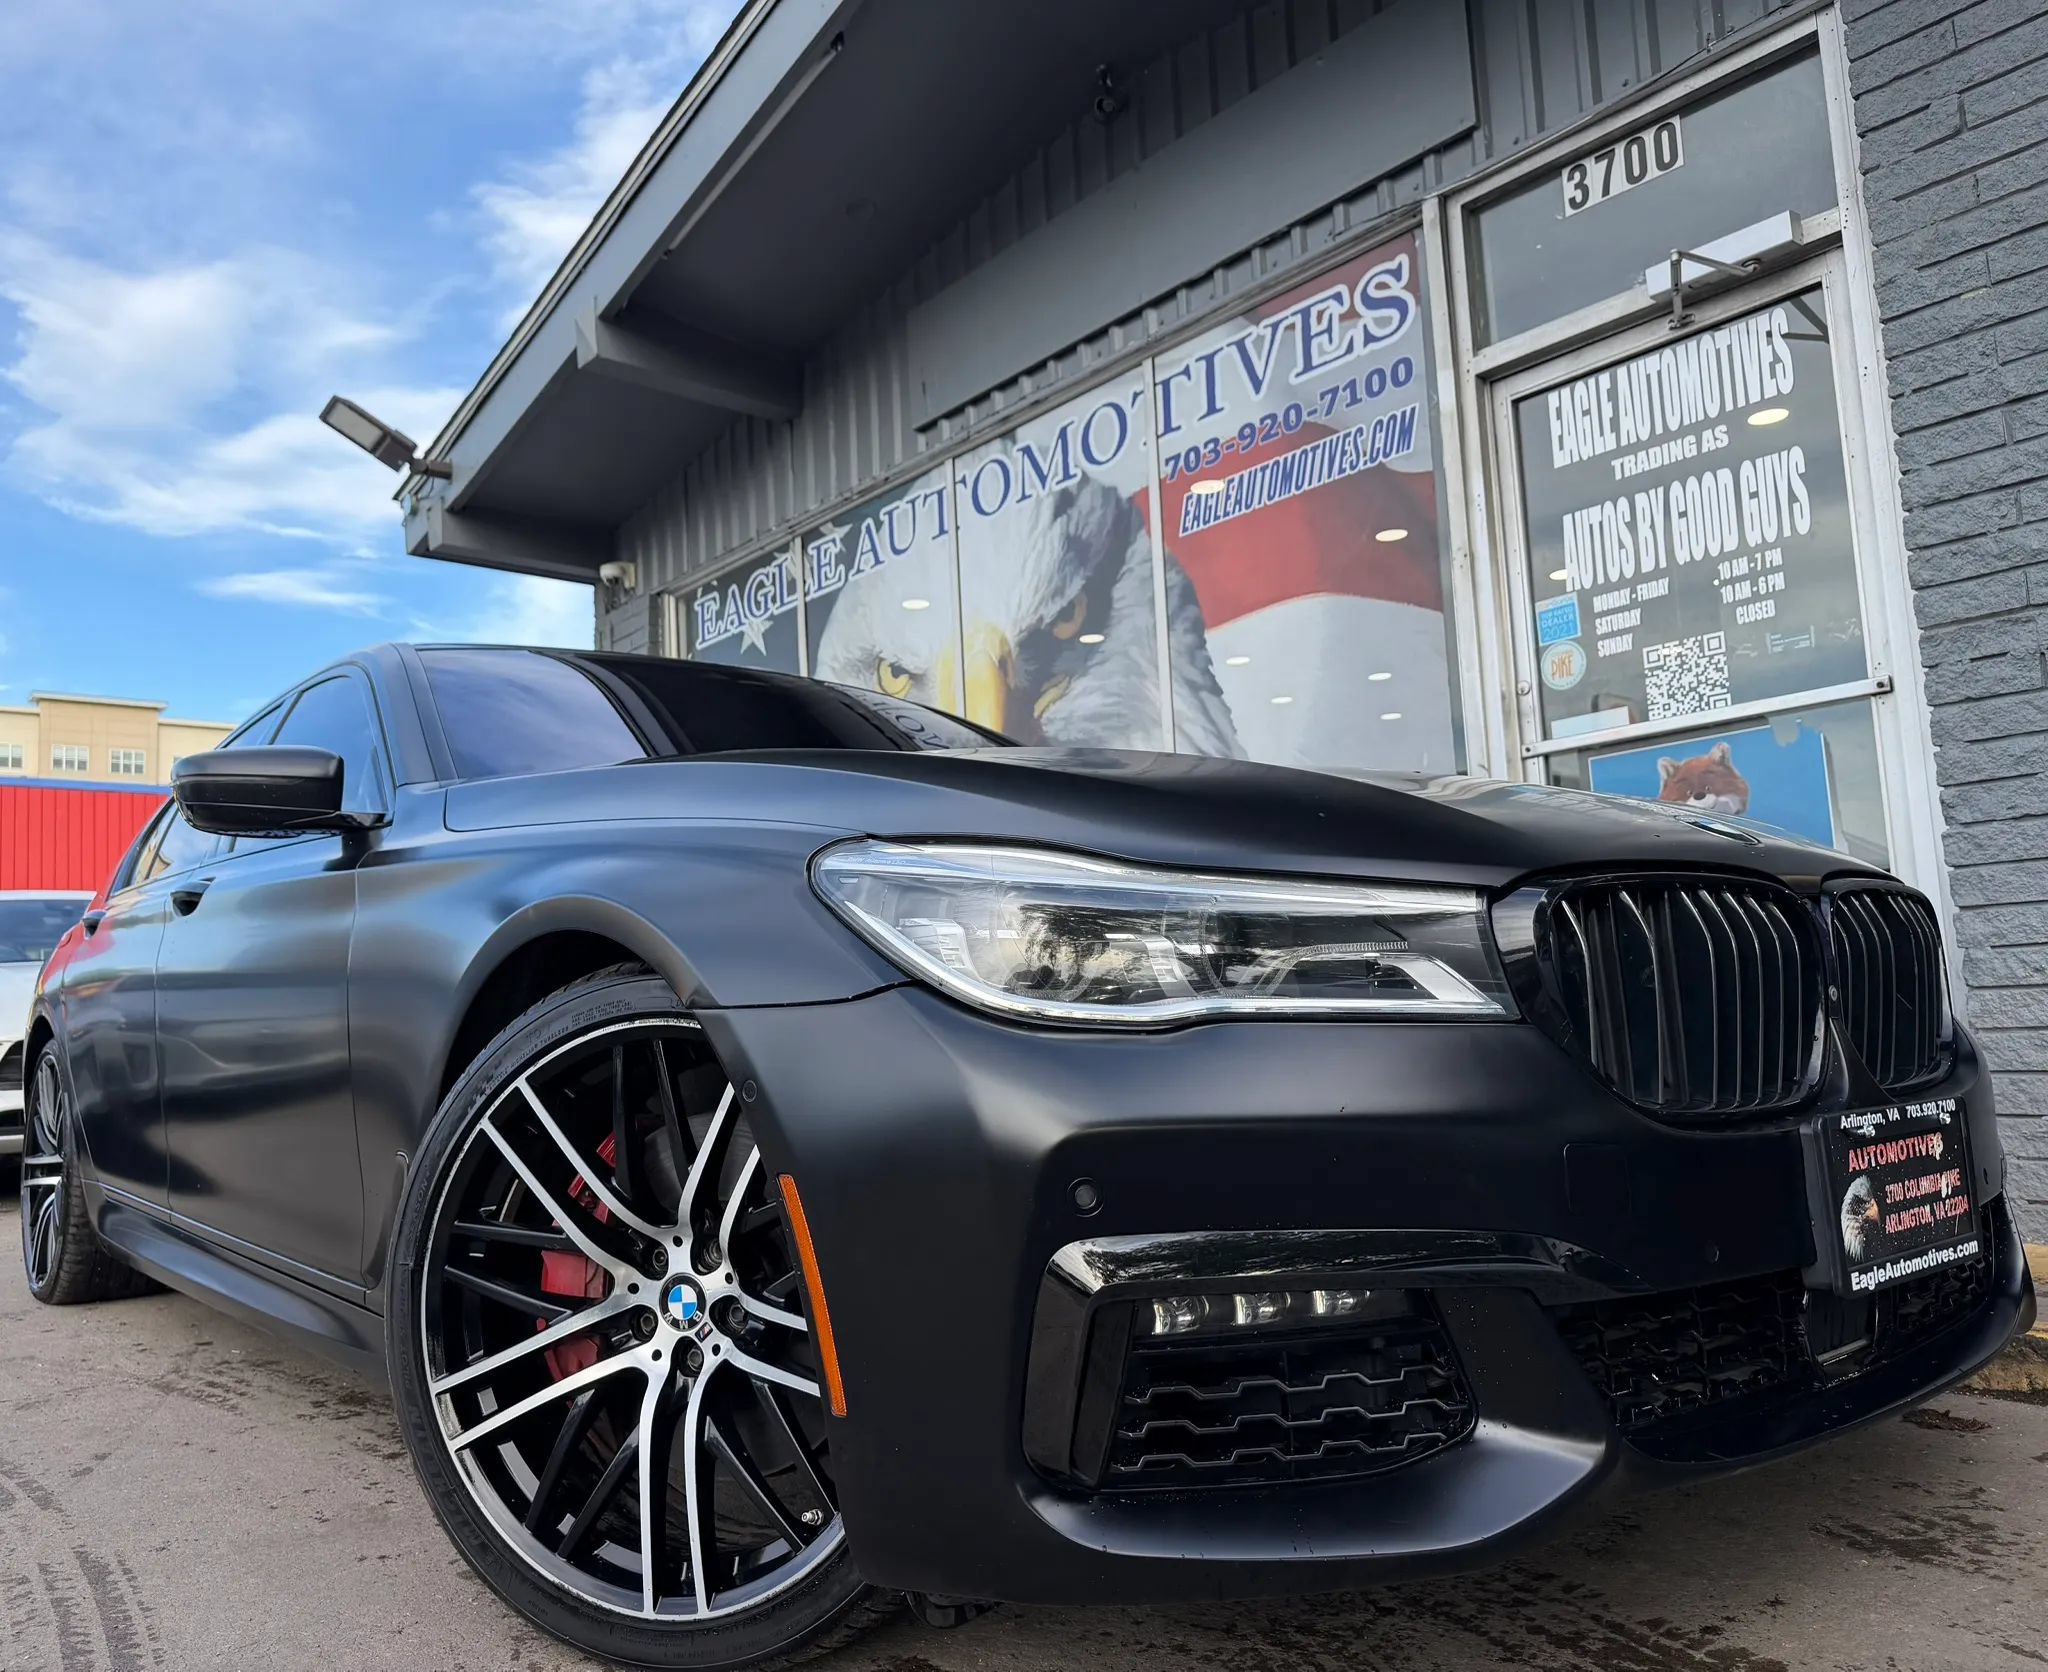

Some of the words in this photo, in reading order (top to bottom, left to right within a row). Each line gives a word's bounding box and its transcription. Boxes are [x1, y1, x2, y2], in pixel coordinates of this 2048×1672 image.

[1566, 120, 1679, 211] 3700
[1548, 372, 1617, 469] EAGLE
[1617, 307, 1794, 447] AUTOMOTIVES
[1165, 356, 1413, 481] 703-920-7100
[694, 535, 845, 650] EAGLE
[850, 254, 1416, 581] AUTOMOTIVES
[1611, 435, 1698, 480] TRADING
[1701, 424, 1729, 453] AS
[1179, 402, 1419, 537] EAGLEAUTOMOTIVES.COM
[1562, 496, 1636, 592] AUTOS
[1634, 486, 1667, 573] BY
[1669, 467, 1739, 565] GOOD
[1739, 445, 1812, 548] GUYS
[1717, 560, 1731, 580] 10
[1731, 556, 1749, 577] AM
[1754, 552, 1762, 571] 7
[1765, 547, 1783, 568] PM
[1593, 587, 1631, 613] MONDAY
[1637, 577, 1670, 602] FRIDAY
[1720, 584, 1734, 604] 10
[1734, 579, 1752, 601] AM
[1758, 576, 1767, 595] 6
[1767, 571, 1785, 593] PM
[1541, 613, 1575, 628] DEALER
[1595, 608, 1642, 636] SATURDAY
[1736, 599, 1776, 625] CLOSED
[1543, 622, 1576, 642] 2021
[1597, 633, 1633, 658] SUNDAY
[1840, 1112, 1885, 1130] Arlington,
[1886, 1107, 1900, 1122] VA
[1905, 1099, 1956, 1118] 703.920.7100
[1885, 1182, 1904, 1204] 3700
[1904, 1173, 1942, 1199] COLUMBIA
[1885, 1204, 1934, 1234] ARLINGTON,
[1934, 1201, 1946, 1220] VA
[1850, 1238, 1979, 1292] EagleAutomotives.com
[663, 1310, 703, 1330] BMW
